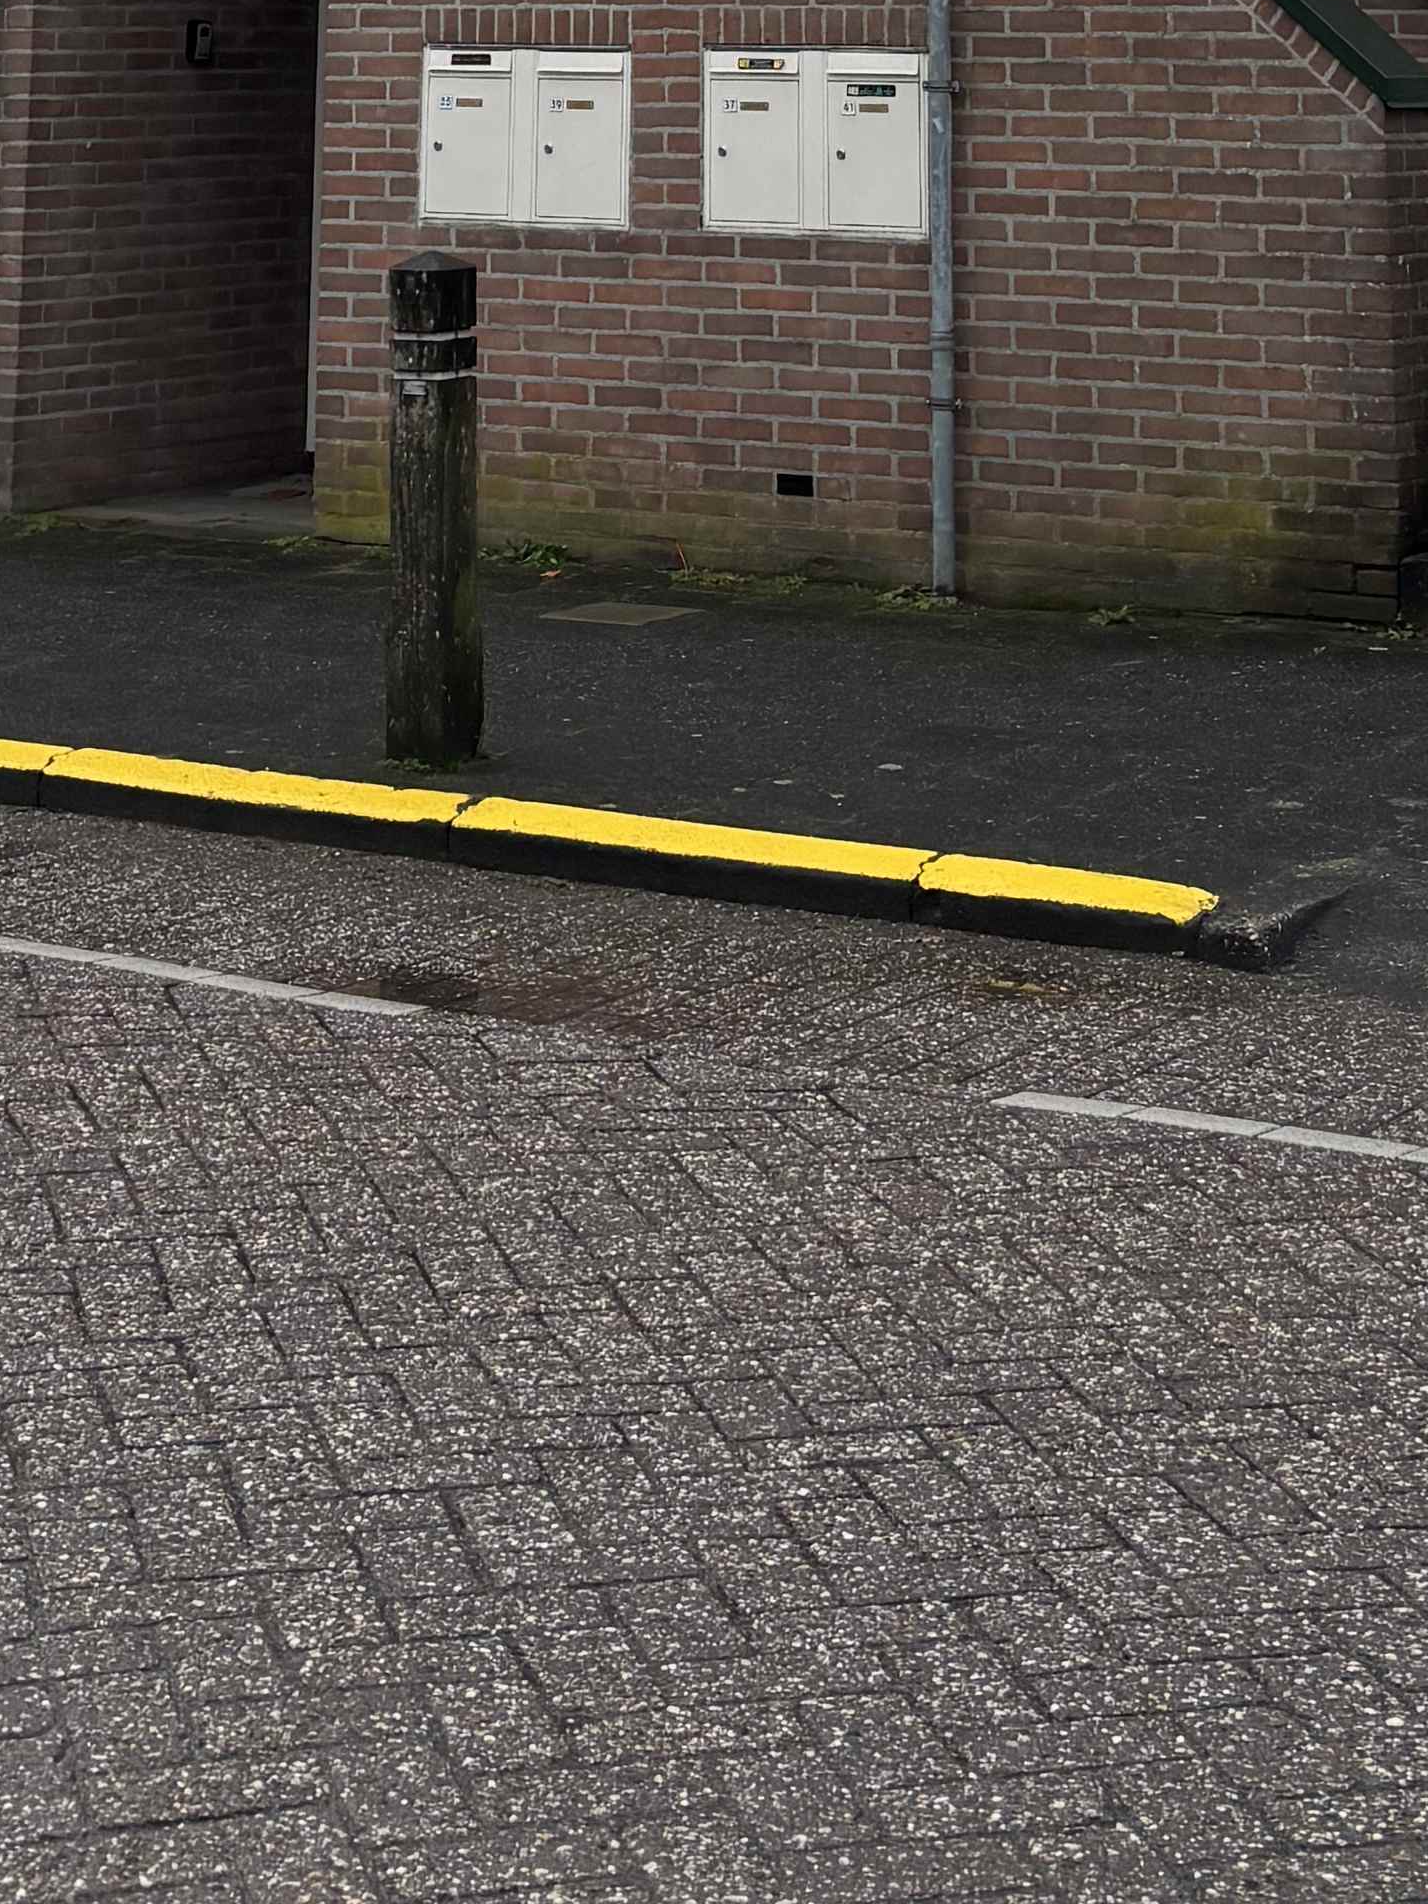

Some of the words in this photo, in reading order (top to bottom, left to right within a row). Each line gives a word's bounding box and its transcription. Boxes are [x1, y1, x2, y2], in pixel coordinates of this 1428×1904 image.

[549, 99, 562, 110] 39
[723, 99, 735, 110] 37
[843, 102, 854, 112] 41
